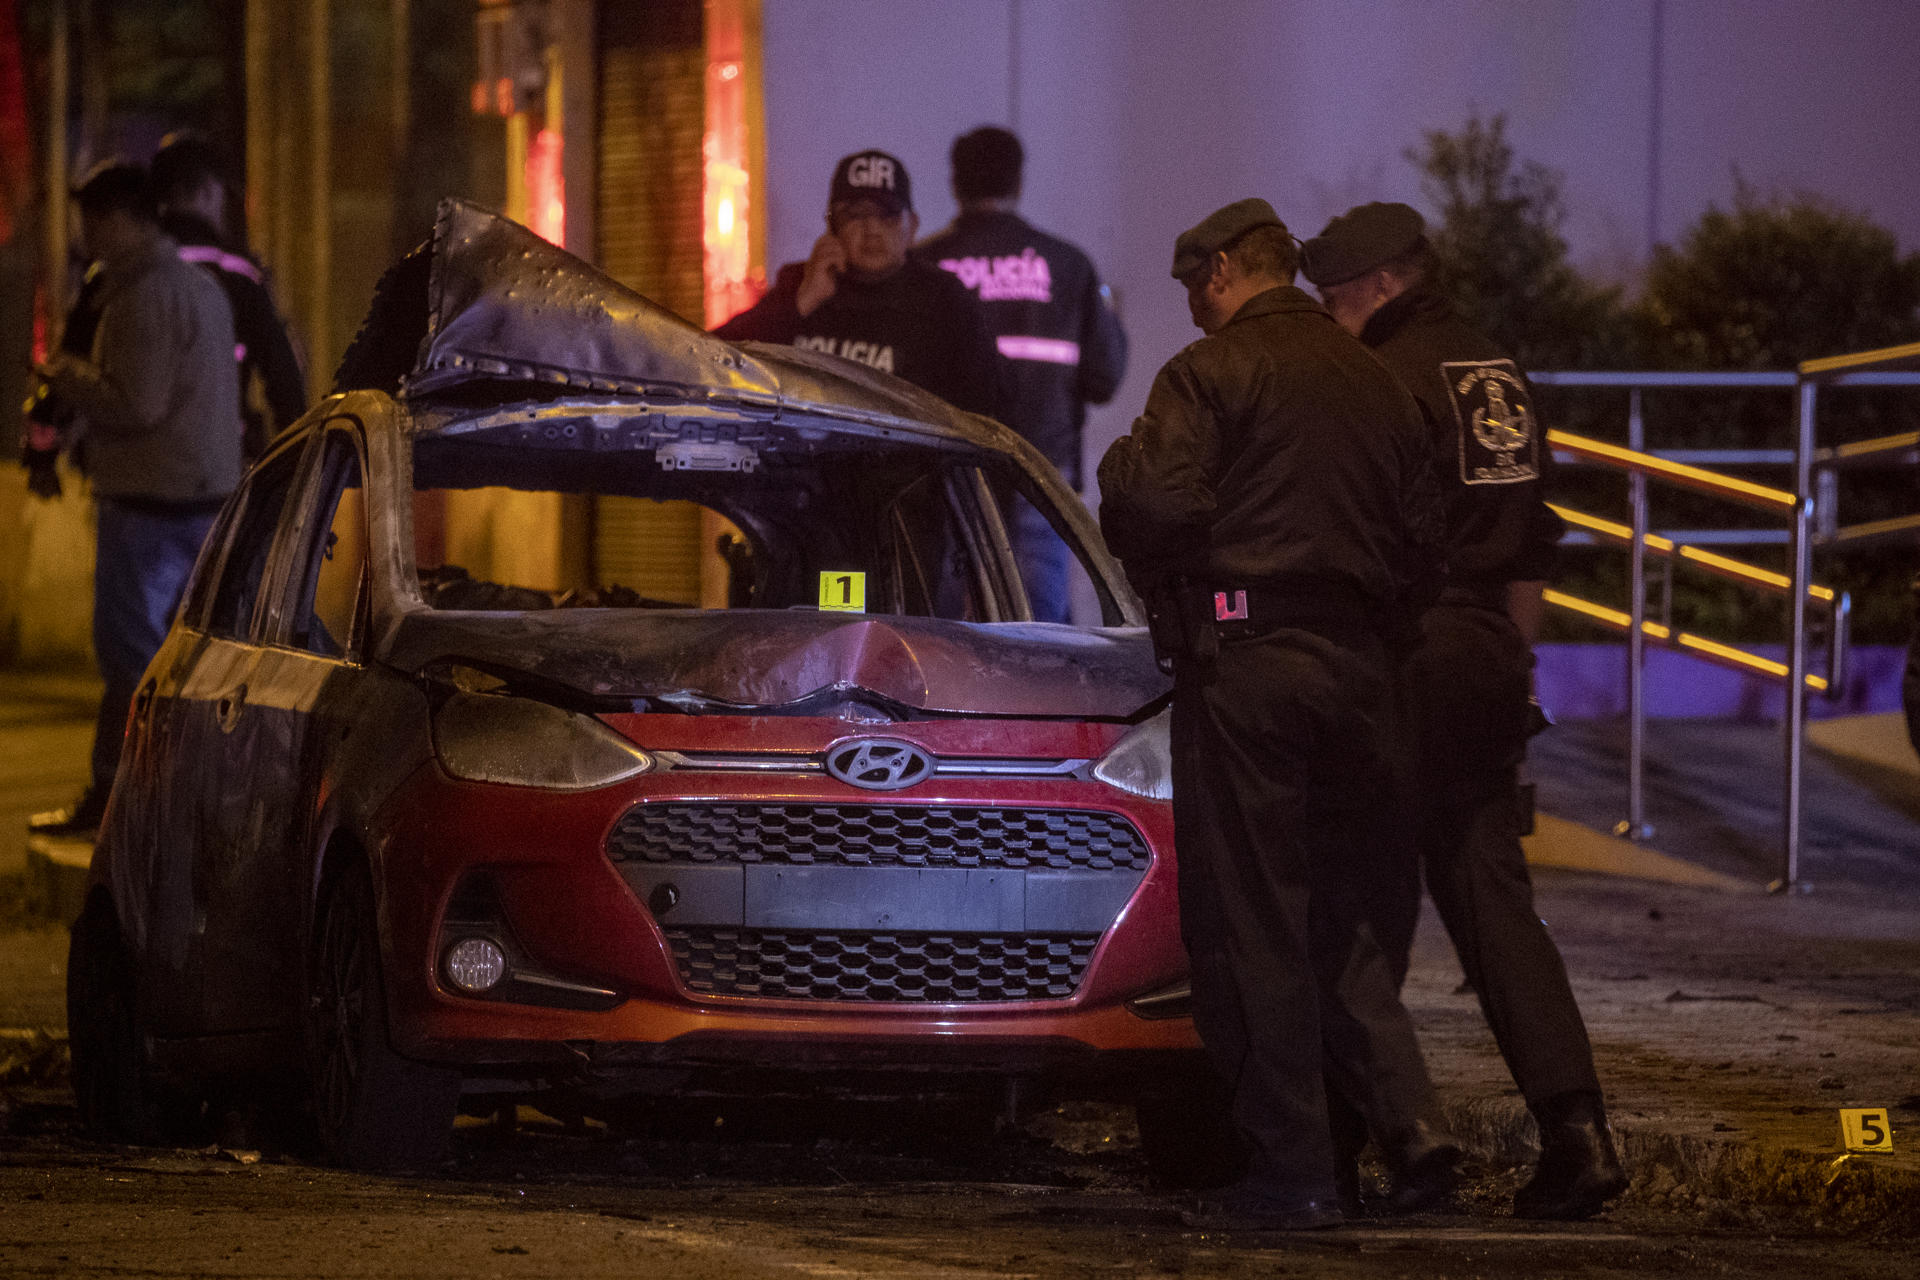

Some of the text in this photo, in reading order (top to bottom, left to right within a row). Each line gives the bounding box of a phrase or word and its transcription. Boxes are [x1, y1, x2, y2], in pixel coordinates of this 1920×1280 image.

[848, 157, 895, 190] GIR
[836, 575, 851, 604] 1
[1861, 1114, 1885, 1146] 5
